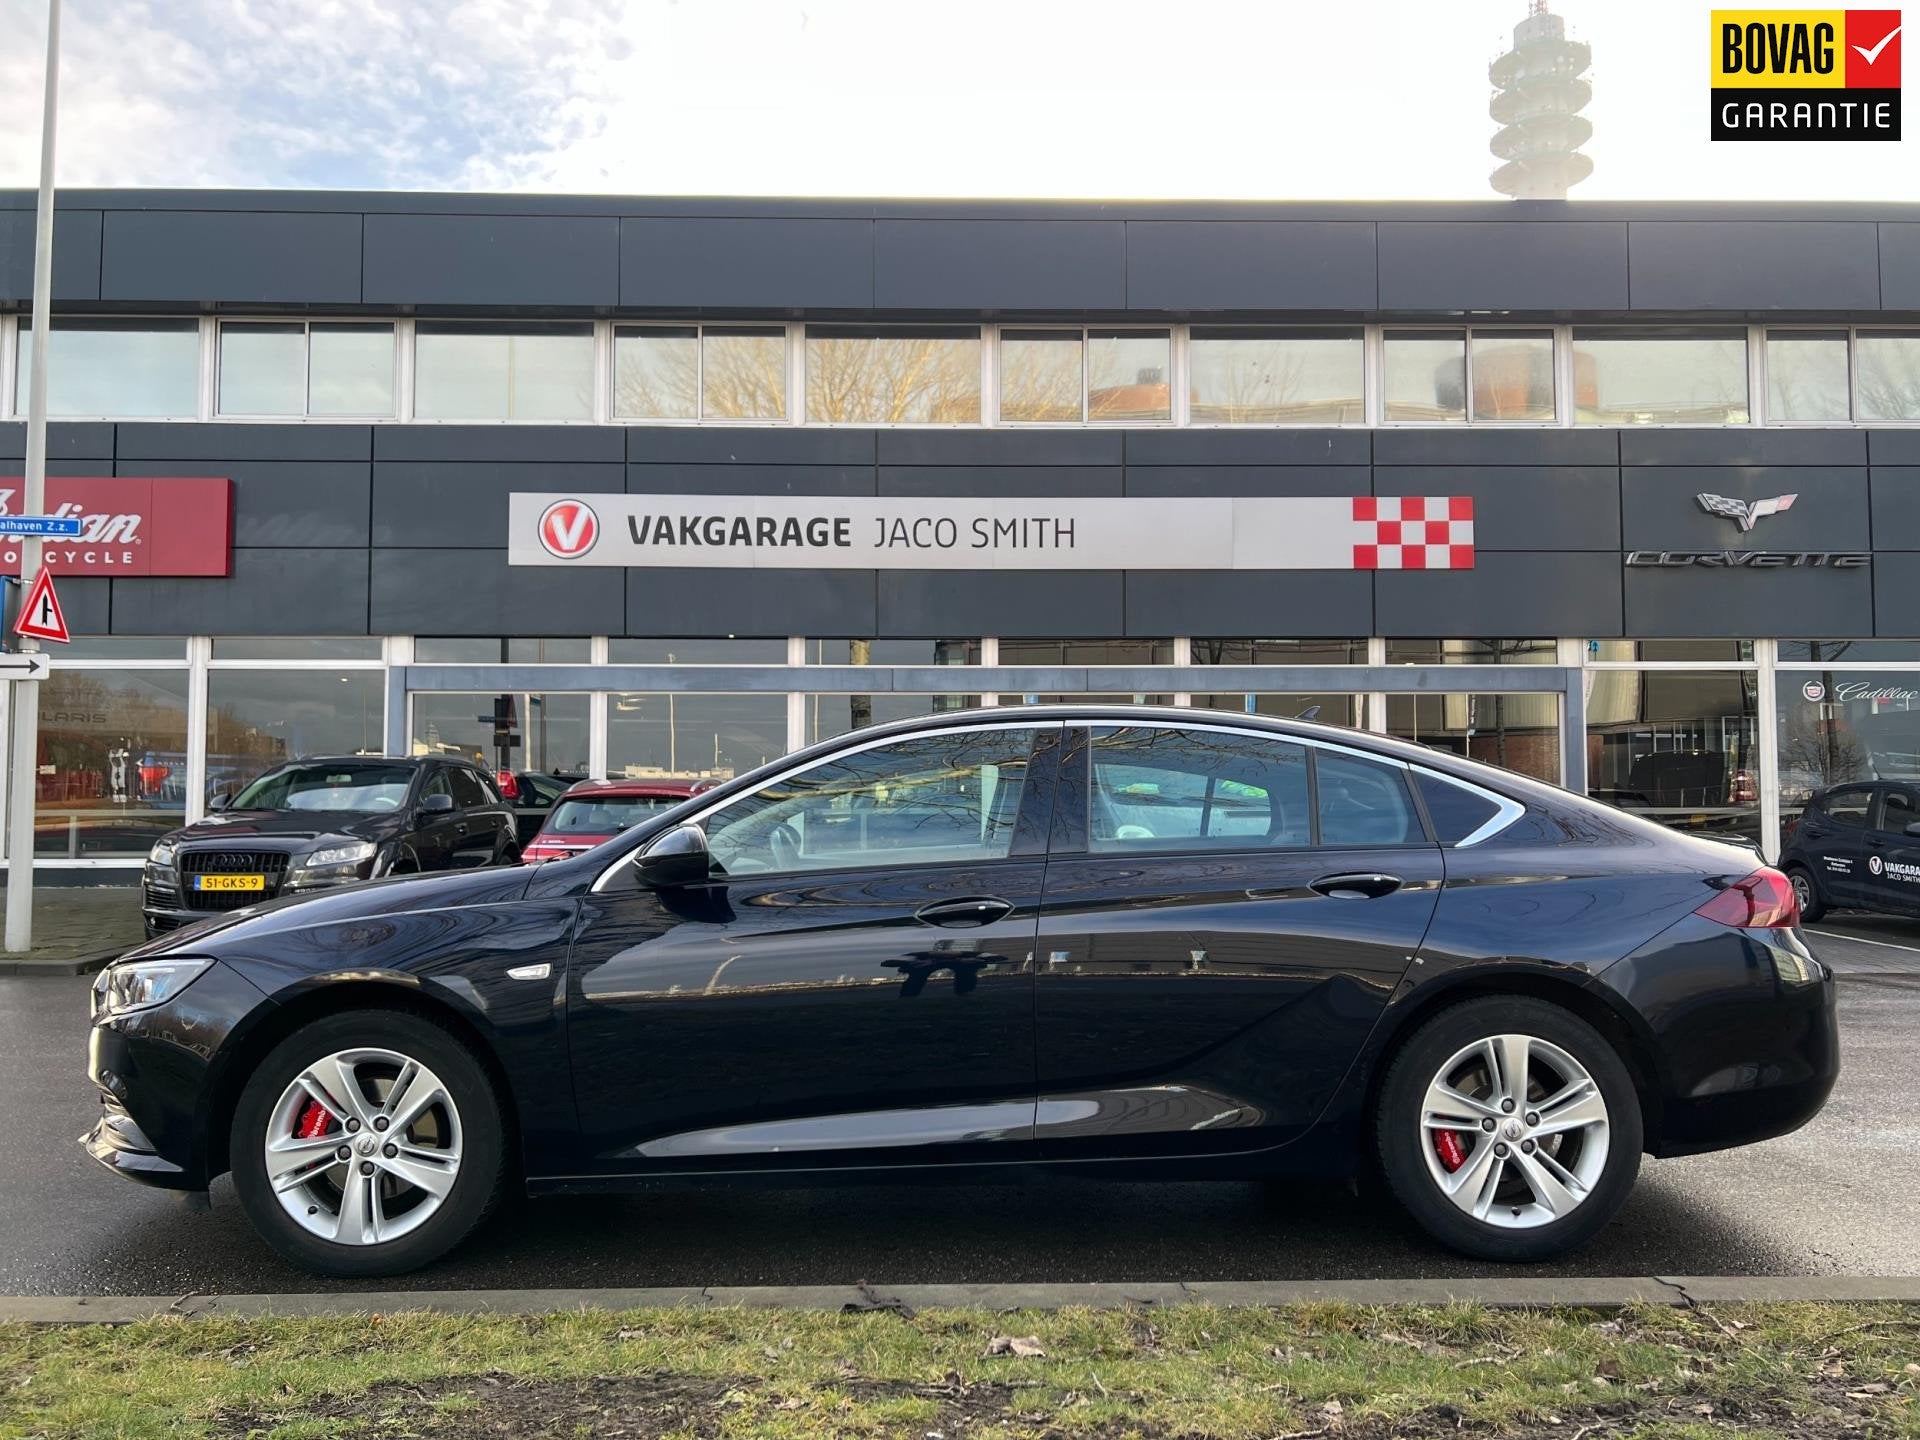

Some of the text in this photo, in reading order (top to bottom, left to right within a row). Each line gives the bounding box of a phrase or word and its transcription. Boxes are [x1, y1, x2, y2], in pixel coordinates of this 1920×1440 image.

[627, 515, 1075, 548] VAKGARAGE JACO SMITH
[4, 551, 133, 564] OCYCLE
[1625, 550, 1873, 567] CORVETTE
[1835, 681, 1919, 702] Cadillac
[38, 711, 107, 724] LARIS
[206, 877, 258, 888] 51-GKS-9
[310, 1107, 326, 1136] bremb
